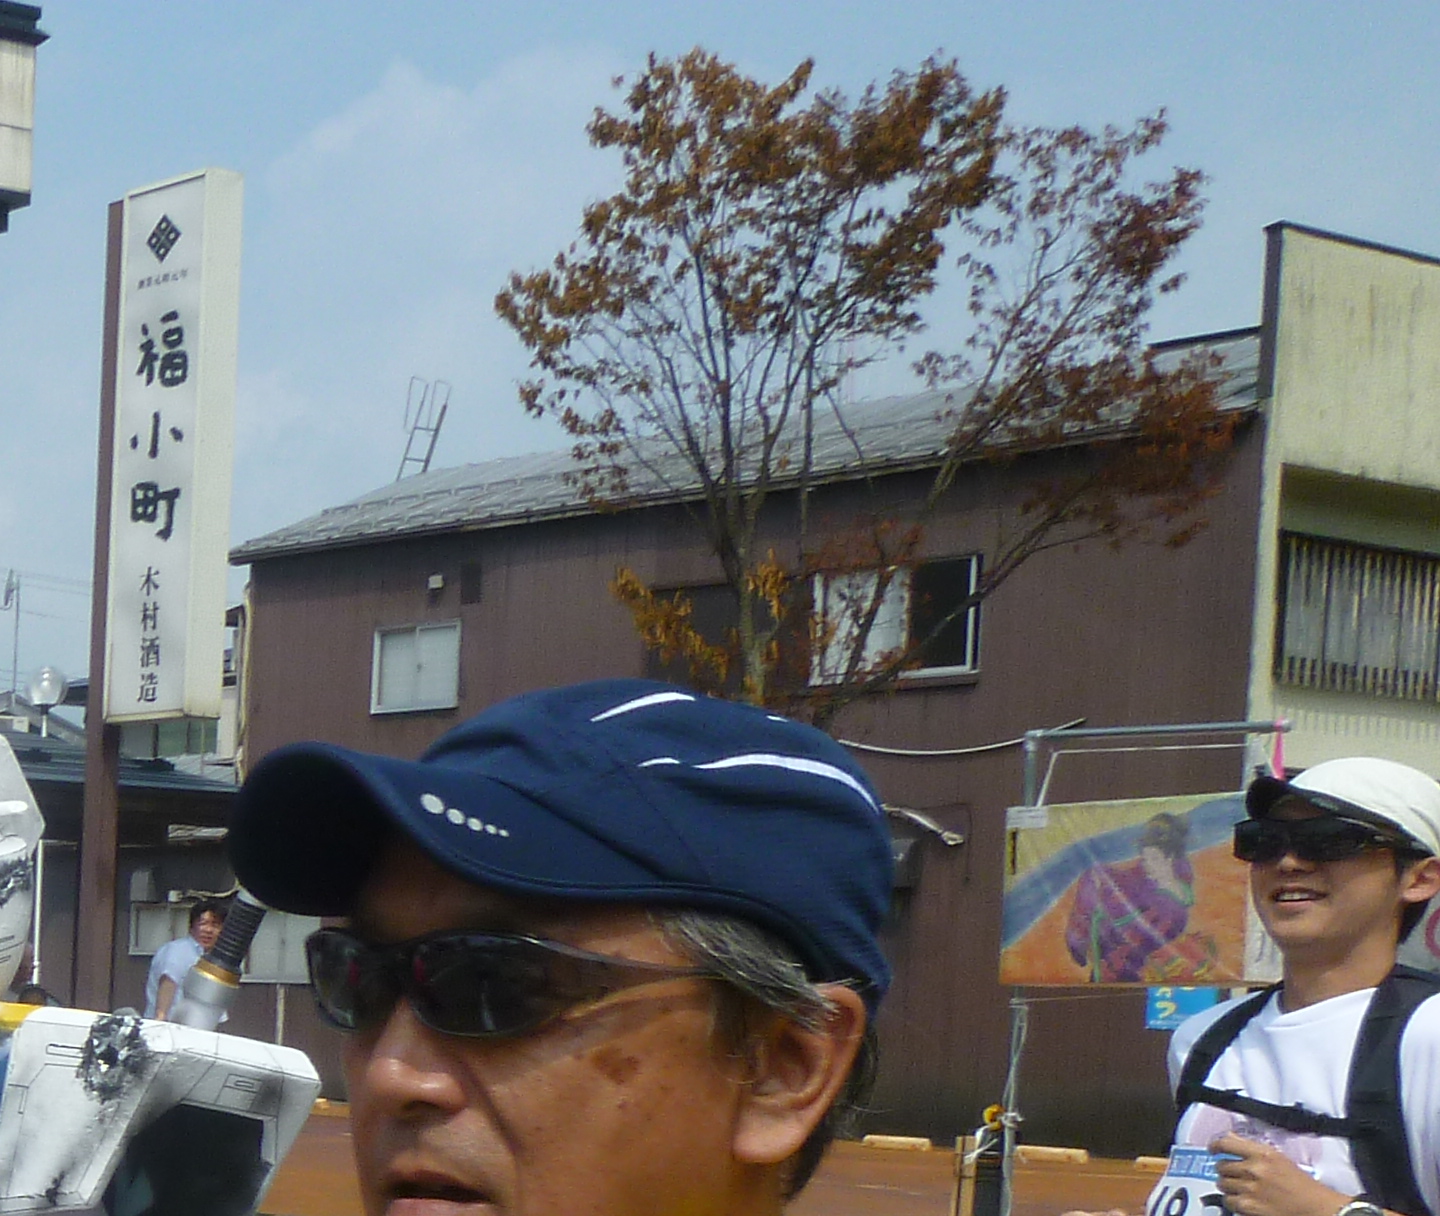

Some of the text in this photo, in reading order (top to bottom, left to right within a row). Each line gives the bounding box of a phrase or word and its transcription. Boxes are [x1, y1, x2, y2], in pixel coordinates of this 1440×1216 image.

[130, 311, 189, 541] 福小町
[138, 566, 161, 703] 木村酒造
